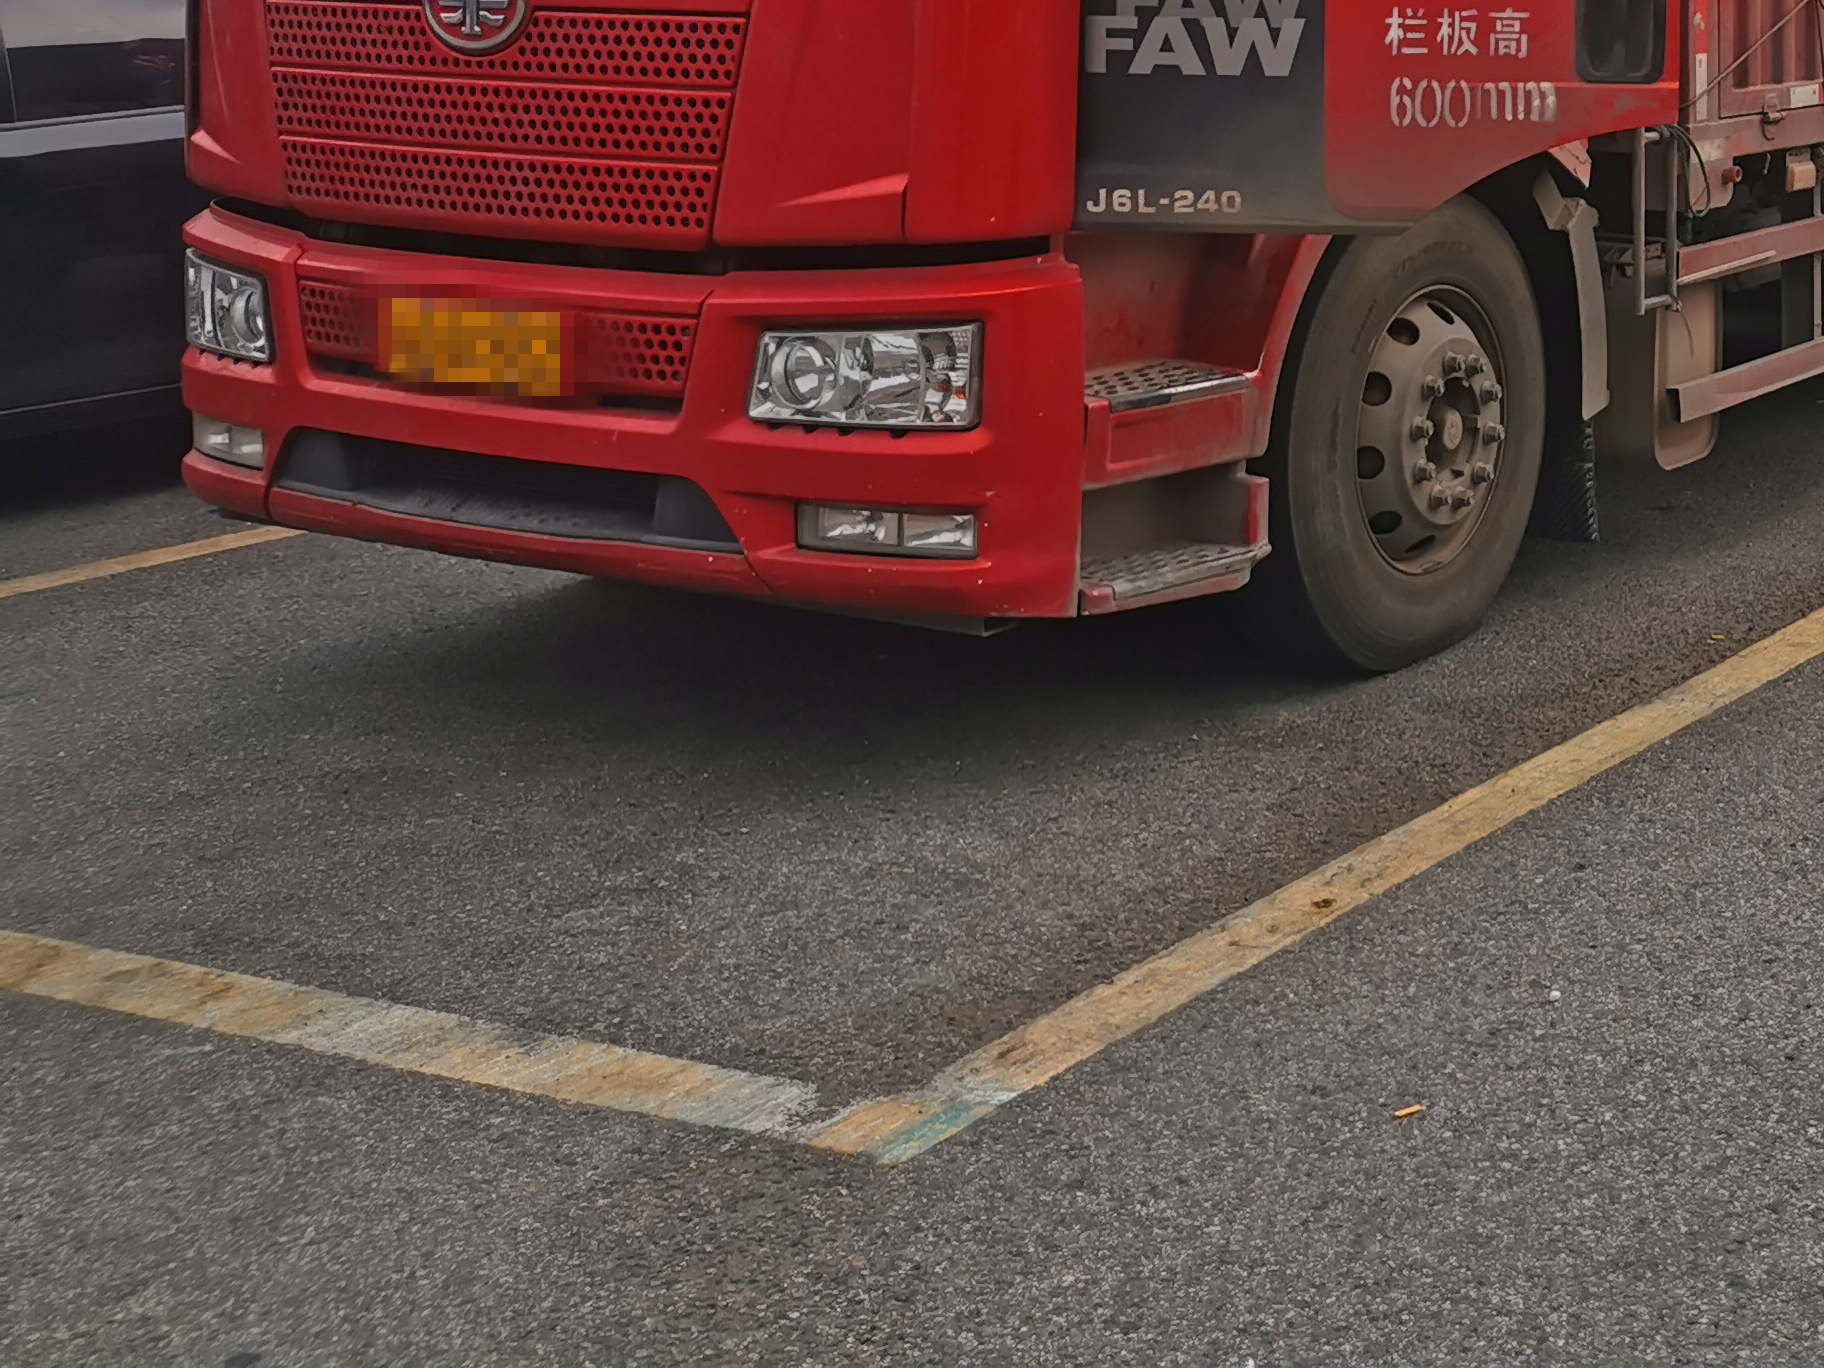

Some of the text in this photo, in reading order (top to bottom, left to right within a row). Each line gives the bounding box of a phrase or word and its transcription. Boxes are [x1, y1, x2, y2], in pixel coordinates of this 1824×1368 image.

[1085, 15, 1306, 77] FAW
[1384, 6, 1530, 58] 栏板高
[1390, 76, 1558, 128] 600mm
[1086, 188, 1242, 214] J6L-240
